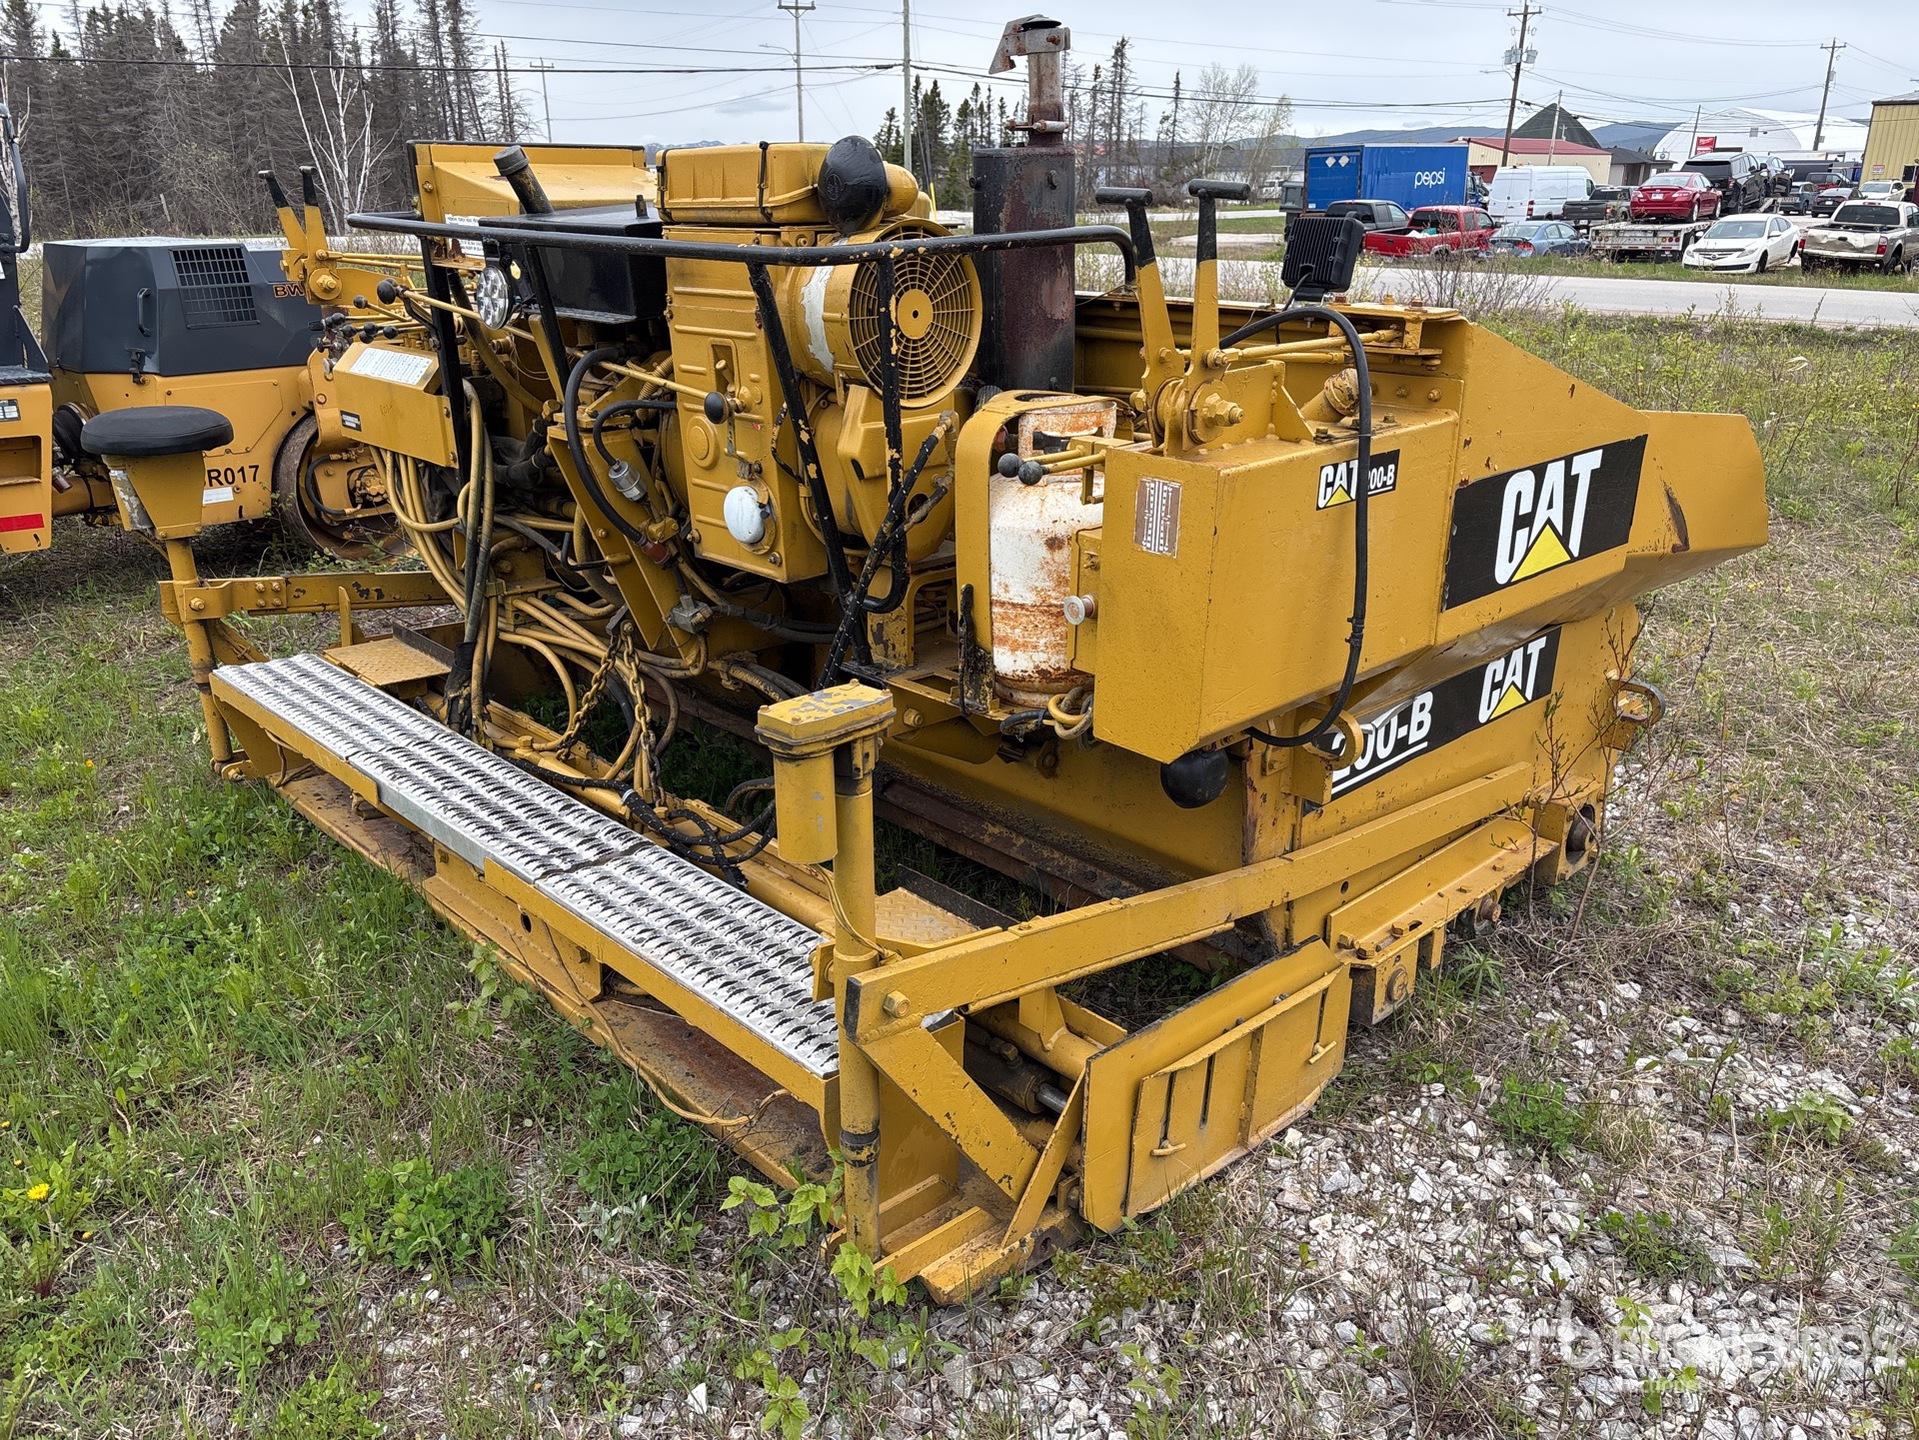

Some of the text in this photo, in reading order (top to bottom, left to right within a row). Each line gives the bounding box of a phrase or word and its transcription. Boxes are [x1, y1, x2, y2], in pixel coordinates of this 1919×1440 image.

[1414, 167, 1446, 189] pepsi
[203, 465, 259, 487] R017
[1318, 460, 1396, 508] CAT 00-B
[1494, 448, 1604, 585] CAT
[1478, 636, 1547, 724] CAT
